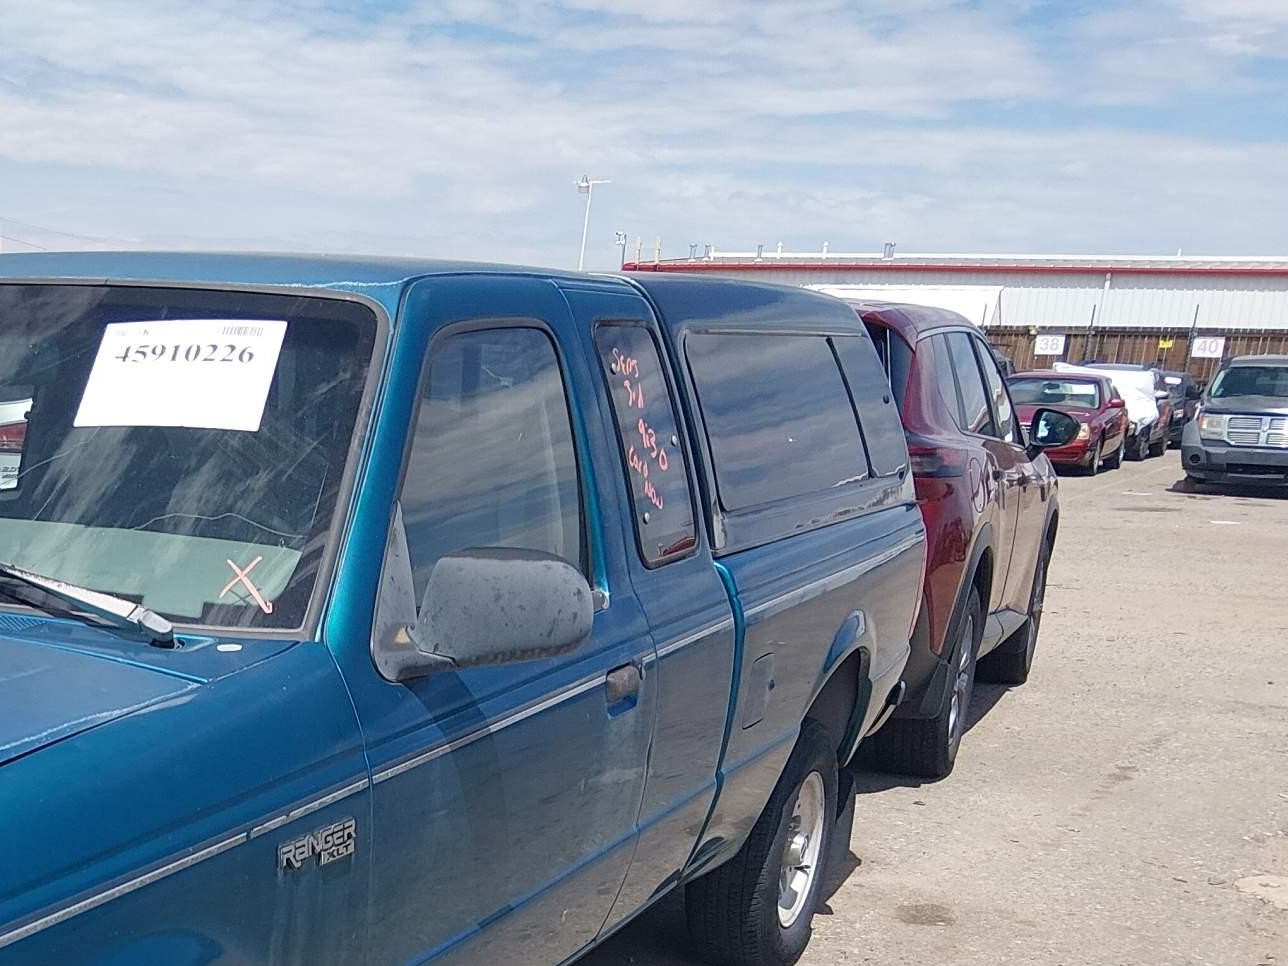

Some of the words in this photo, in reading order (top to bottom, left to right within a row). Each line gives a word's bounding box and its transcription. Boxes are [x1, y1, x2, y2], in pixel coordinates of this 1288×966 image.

[1039, 337, 1060, 352] 38
[1198, 340, 1219, 354] 40
[115, 343, 255, 364] 45910226
[279, 818, 357, 868] RANGER
[326, 843, 352, 860] XLT
